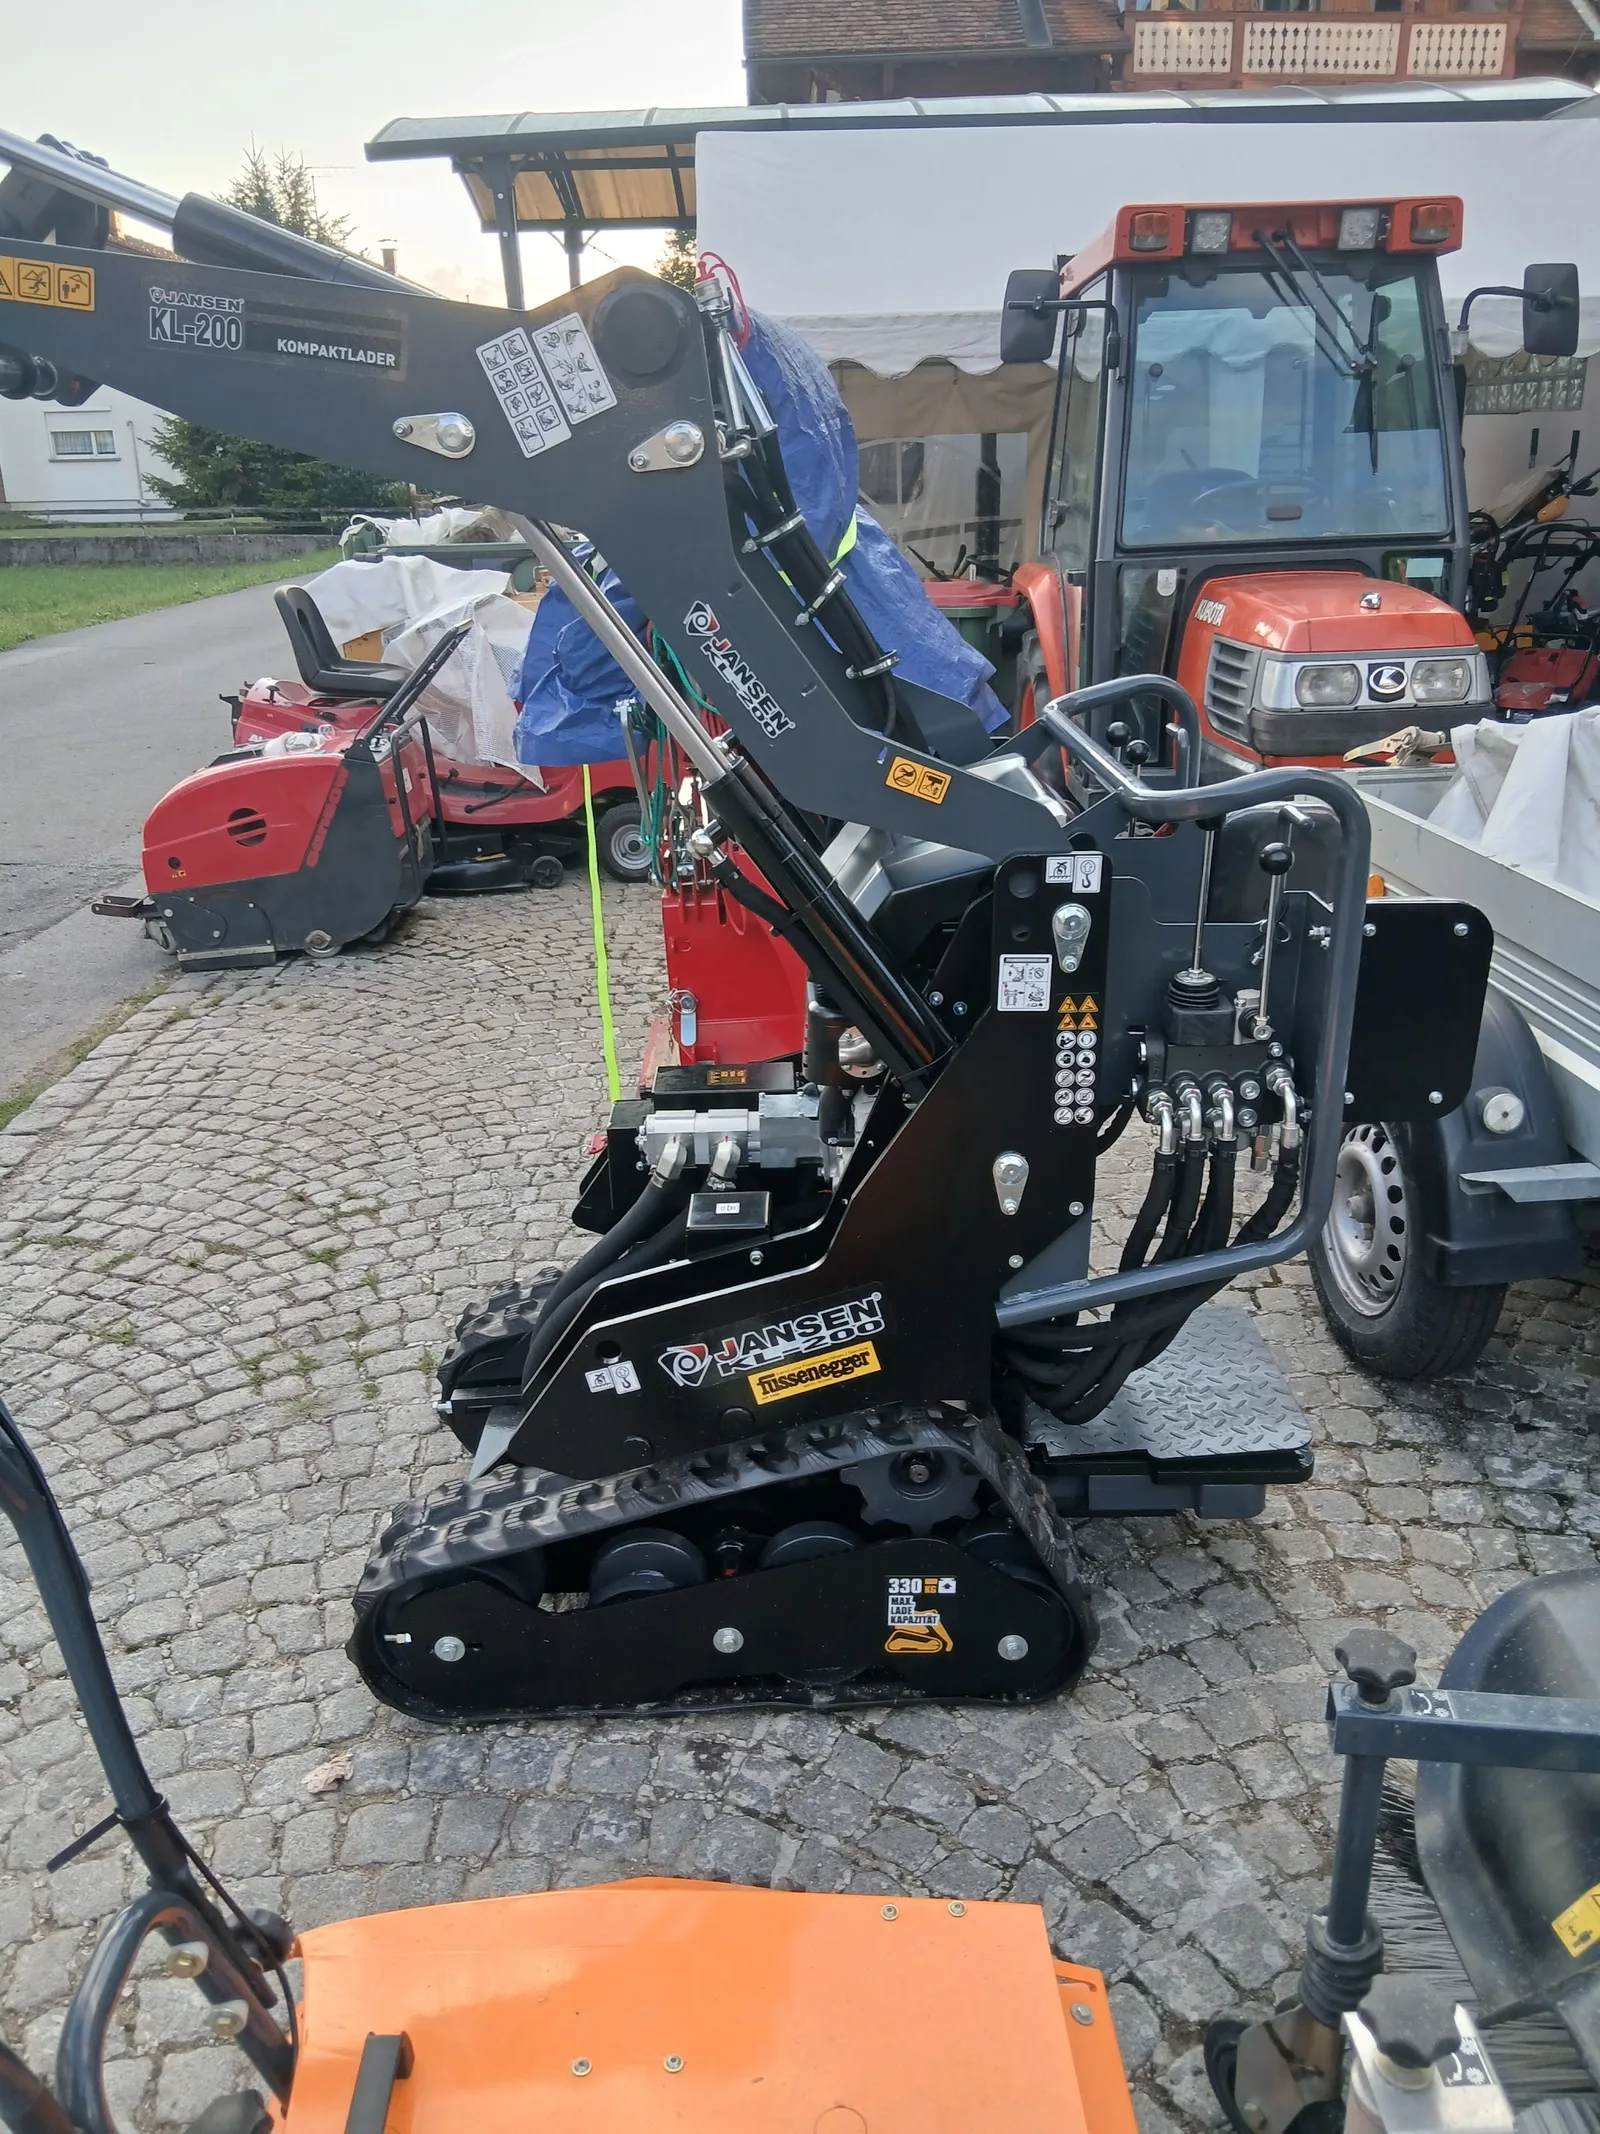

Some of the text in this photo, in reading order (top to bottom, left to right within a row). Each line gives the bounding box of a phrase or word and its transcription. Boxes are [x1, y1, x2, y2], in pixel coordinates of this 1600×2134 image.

[164, 291, 242, 314] JANSEN
[149, 306, 243, 350] KL-200
[277, 338, 396, 367] KOMPAKTLADER
[1194, 598, 1227, 627] KUBOTA
[699, 640, 779, 740] KL-200
[709, 636, 793, 733] JANSEN
[713, 1297, 884, 1362] JANSEN
[715, 1317, 886, 1377] KL-200
[888, 1578, 937, 1594] 330 KG
[890, 1606, 912, 1615] LADE
[890, 1614, 938, 1624] KAPAZITÄT
